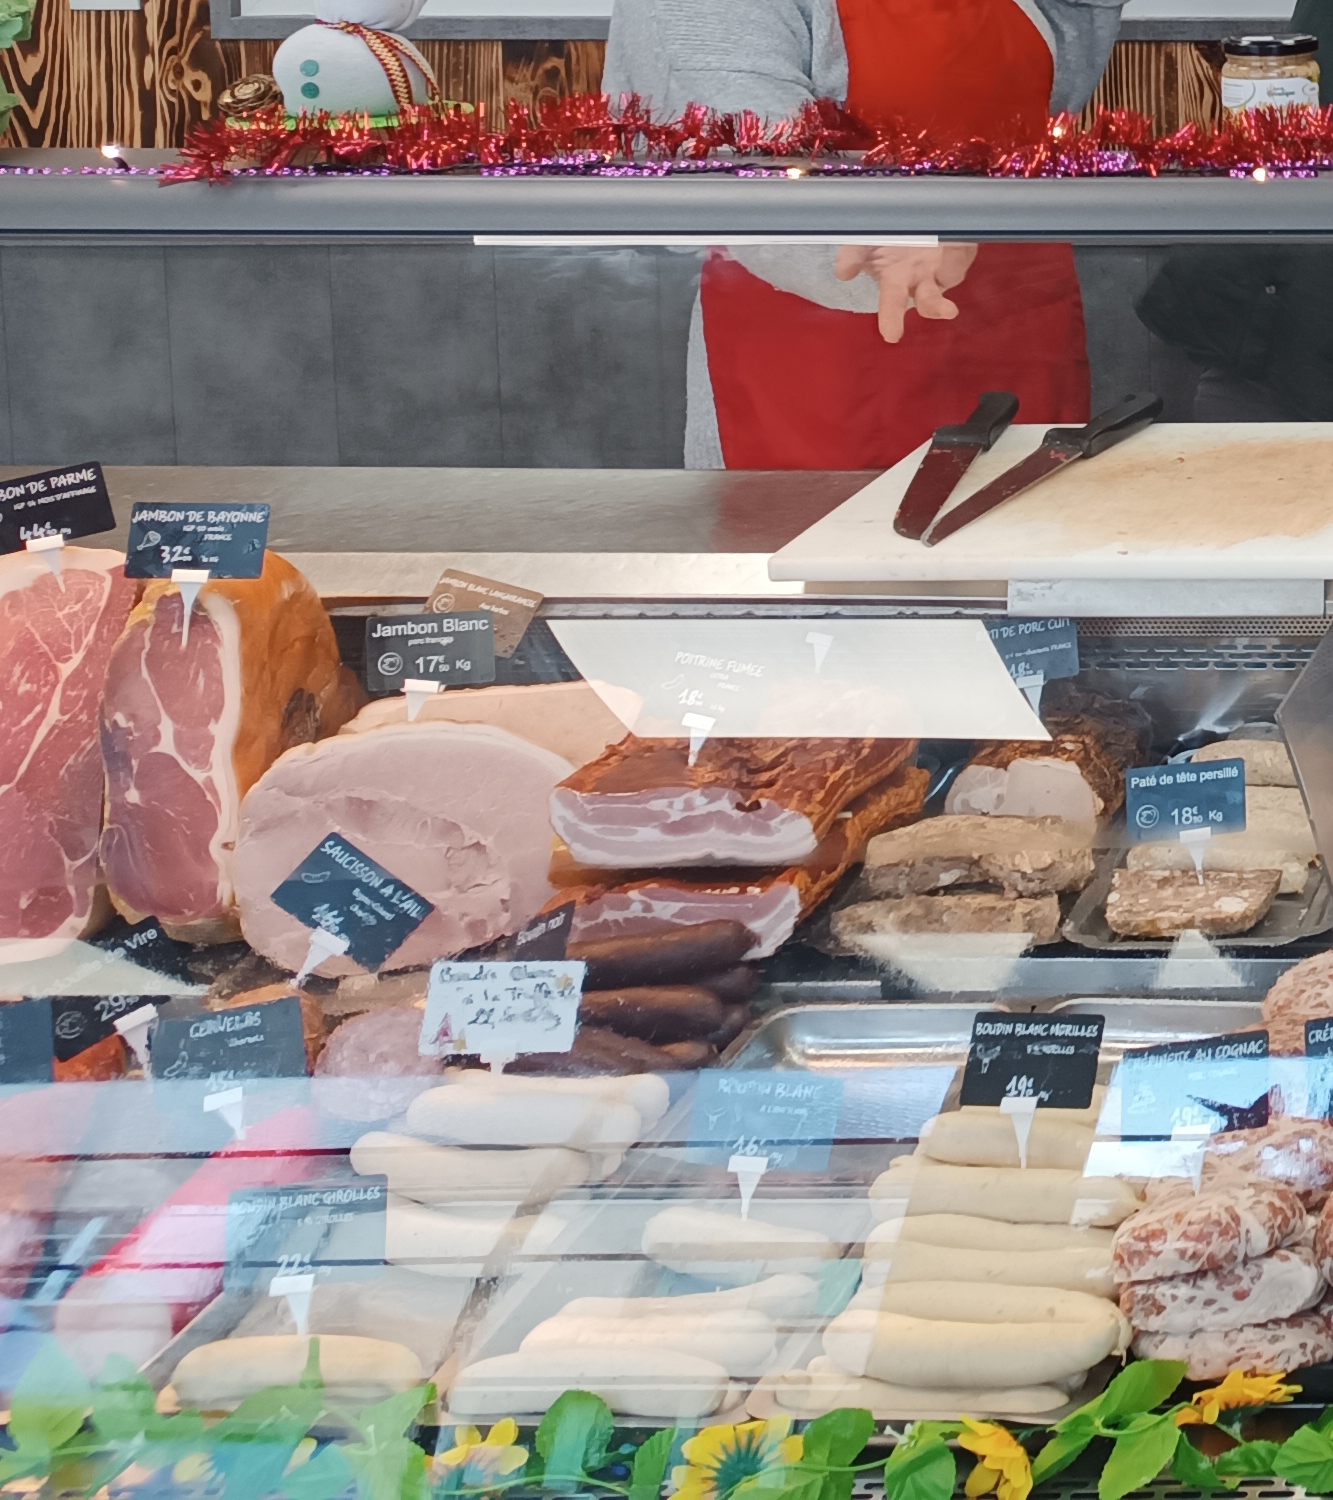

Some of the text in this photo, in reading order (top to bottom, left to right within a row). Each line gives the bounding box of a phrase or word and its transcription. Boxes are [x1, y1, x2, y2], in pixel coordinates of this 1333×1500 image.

[26, 468, 97, 494] DE PARME
[132, 510, 266, 523] JAMBON DE BAYONNE
[371, 618, 490, 638] Jambon Blanc
[999, 616, 1071, 639] DE PORC CUIT
[455, 658, 472, 671] Kg
[674, 651, 725, 671] POITRINE
[1130, 765, 1239, 789] Paté de tête persillé
[1208, 809, 1223, 823] Kg
[319, 840, 385, 888] SAUCISSON
[378, 884, 395, 897] A
[105, 927, 158, 964] de Vire
[975, 1022, 1099, 1038] BOUDIN BLANC MORILLES
[1194, 1049, 1212, 1060] AU
[1214, 1039, 1265, 1059] COGNAC
[774, 1082, 824, 1100] BLANC
[279, 1191, 321, 1210] BLANC
[322, 1185, 381, 1205] GIROLLES
